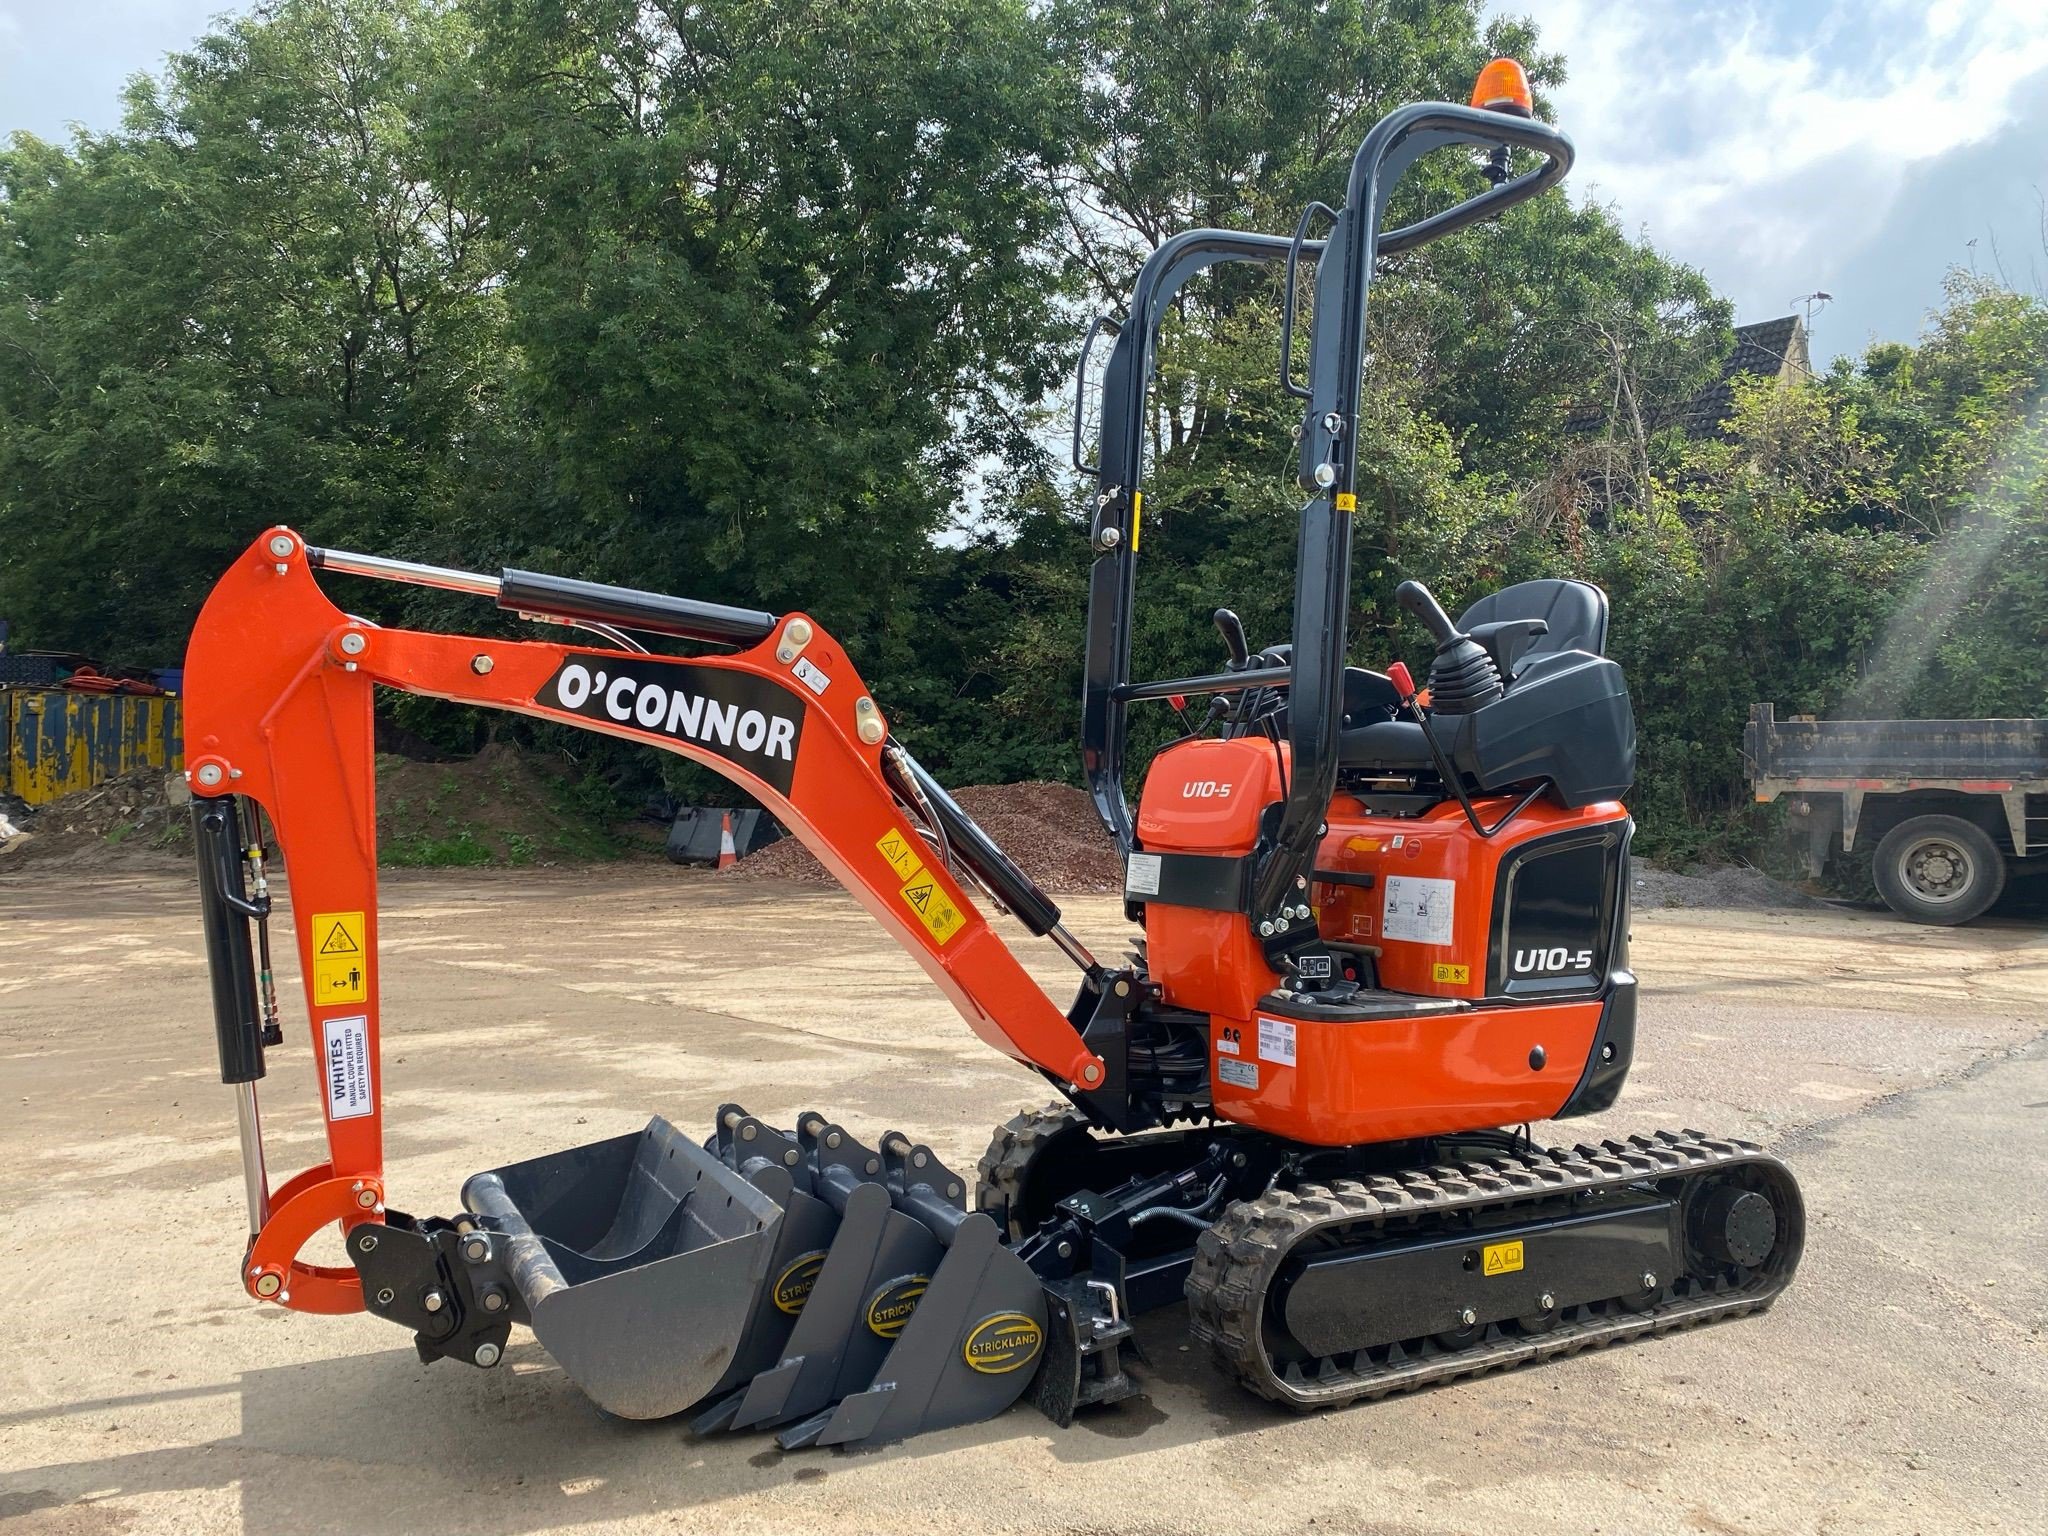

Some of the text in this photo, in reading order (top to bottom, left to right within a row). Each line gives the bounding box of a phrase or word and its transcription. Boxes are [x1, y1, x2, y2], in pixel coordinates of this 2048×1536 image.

[557, 664, 795, 761] O'CONNOR
[1183, 781, 1233, 798] U10-5
[1514, 947, 1593, 973] U10-5
[331, 1038, 345, 1100] WHITES
[346, 1050, 355, 1080] COUPLER
[355, 1033, 366, 1100] SAFETY PIN REQUIRED
[349, 1081, 357, 1107] MANUAL
[971, 1334, 1036, 1355] STRICKLAND
